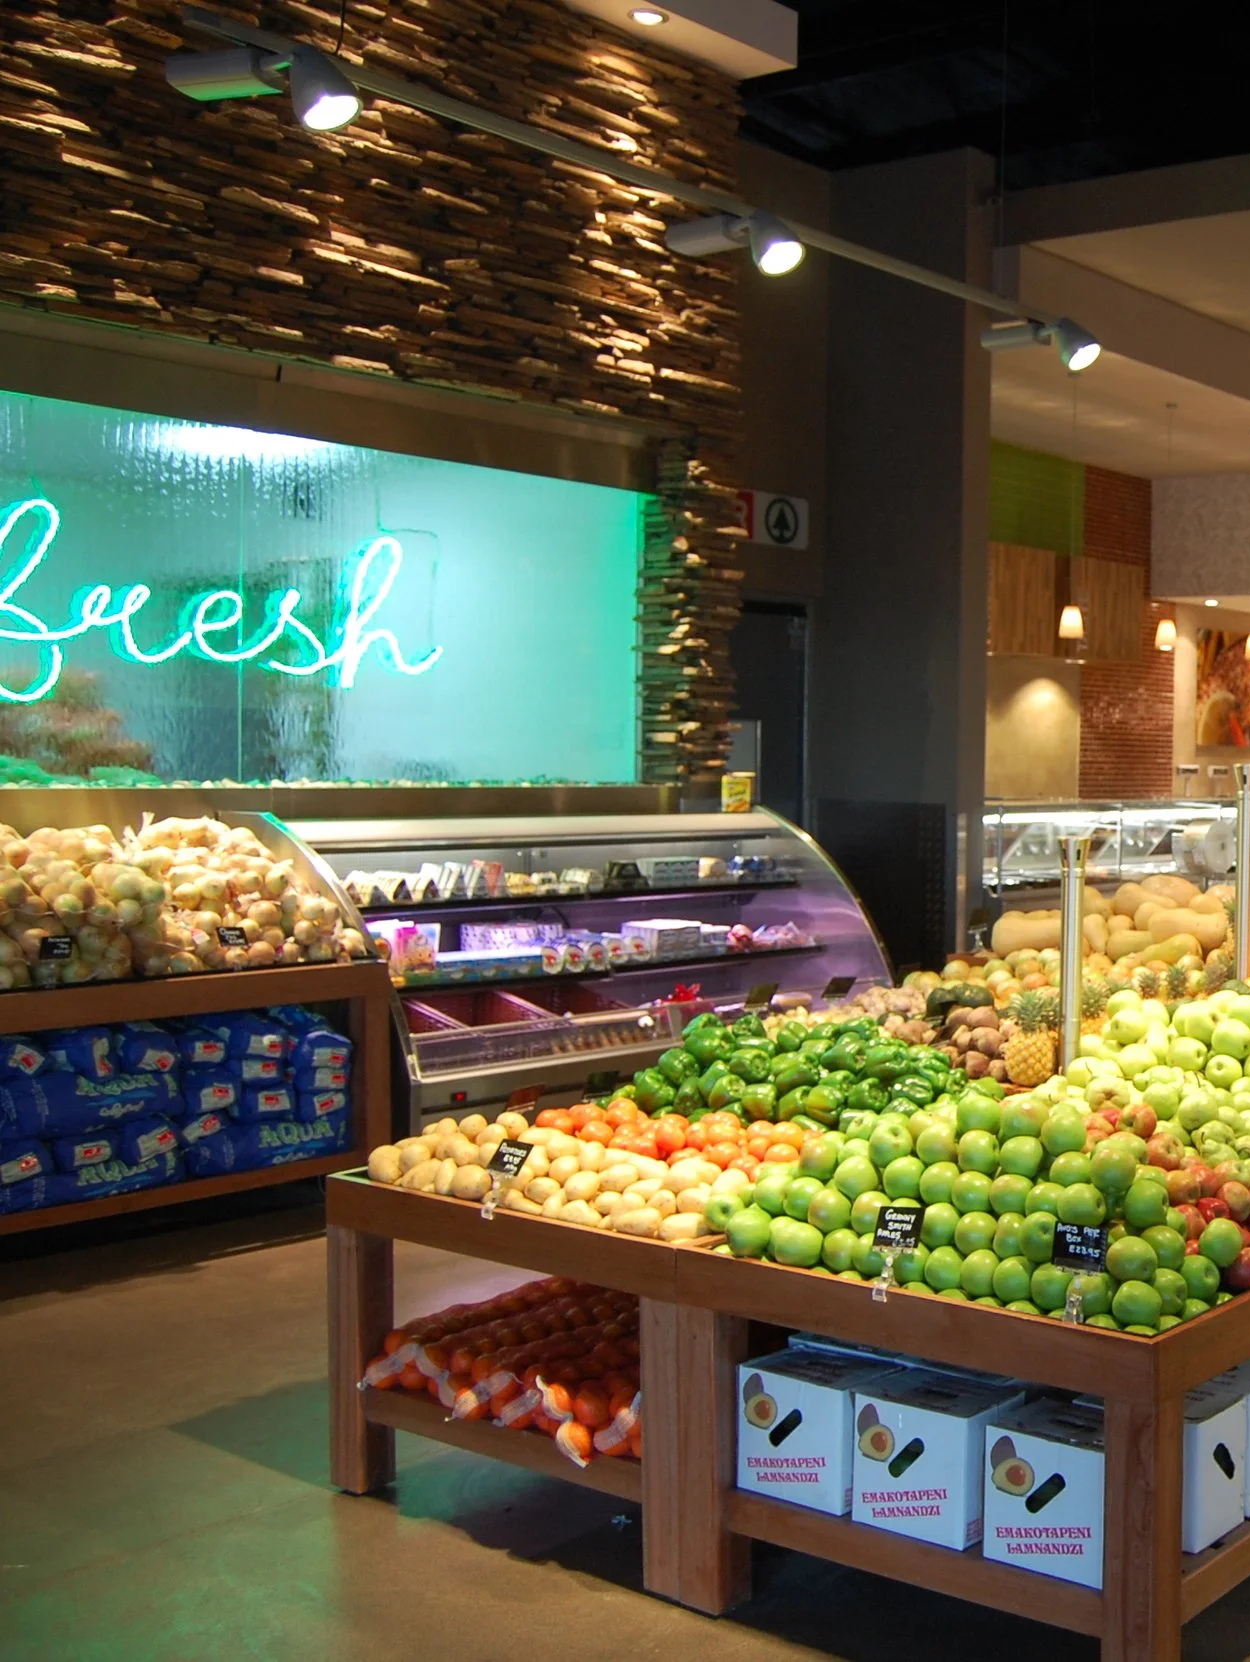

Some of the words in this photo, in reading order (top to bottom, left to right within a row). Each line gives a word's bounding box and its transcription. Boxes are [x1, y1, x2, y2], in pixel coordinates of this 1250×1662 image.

[259, 1117, 335, 1149] AQUA
[746, 1455, 827, 1469] EMAKOTAPENI
[755, 1471, 821, 1484] LAMNANDZI
[861, 1488, 948, 1504] EMAKOTAPENI
[871, 1505, 942, 1519] LAMNANDZI
[994, 1525, 1093, 1540] EMAKOTAPENI
[1006, 1541, 1085, 1556] LAMNANDZI
